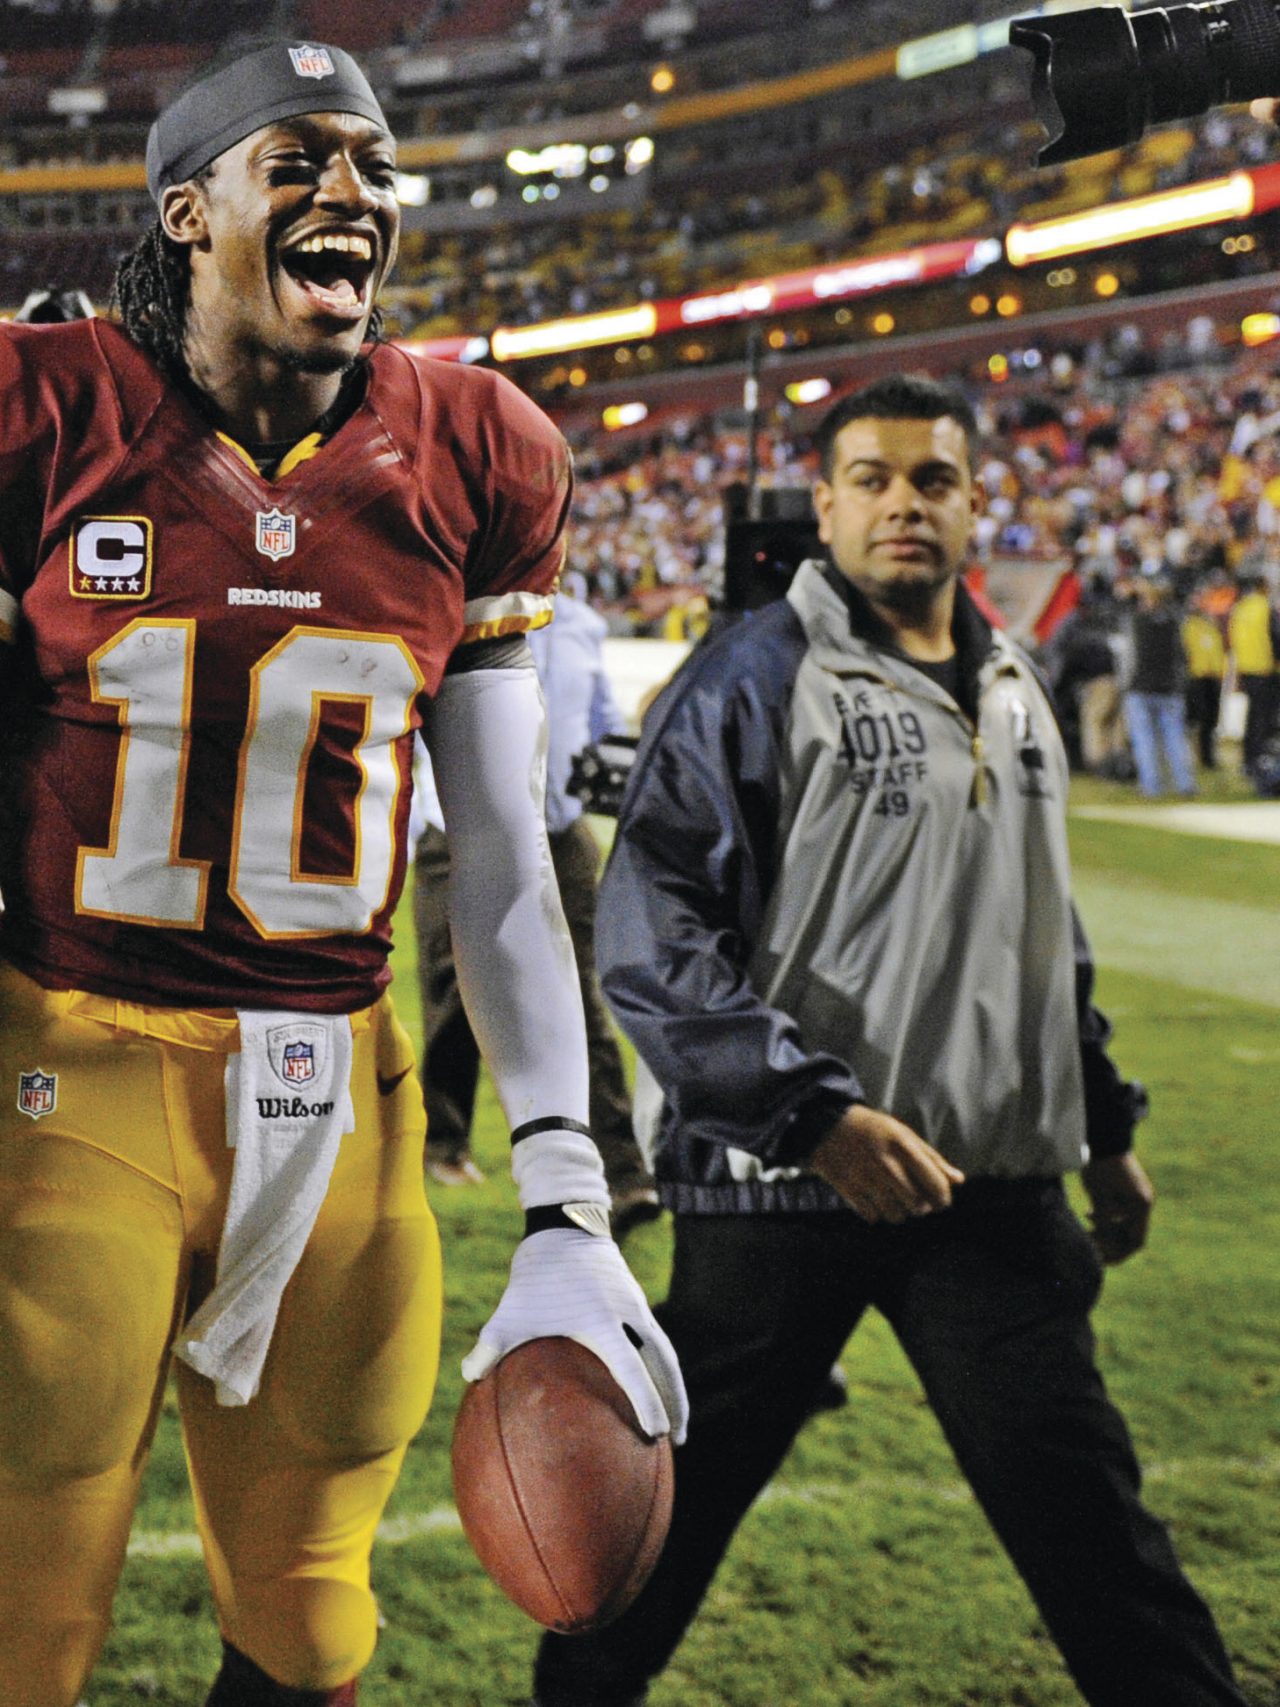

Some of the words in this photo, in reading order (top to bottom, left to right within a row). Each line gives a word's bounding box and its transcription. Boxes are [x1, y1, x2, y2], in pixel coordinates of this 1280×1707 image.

[299, 58, 329, 73] NFL
[76, 520, 145, 578] C
[262, 531, 290, 553] NFL
[227, 587, 323, 609] REDSKINS
[73, 617, 426, 941] 10
[874, 790, 910, 817] 49
[286, 1058, 312, 1080] NFL
[23, 1089, 51, 1111] NFL
[256, 1096, 335, 1119] Wilson
